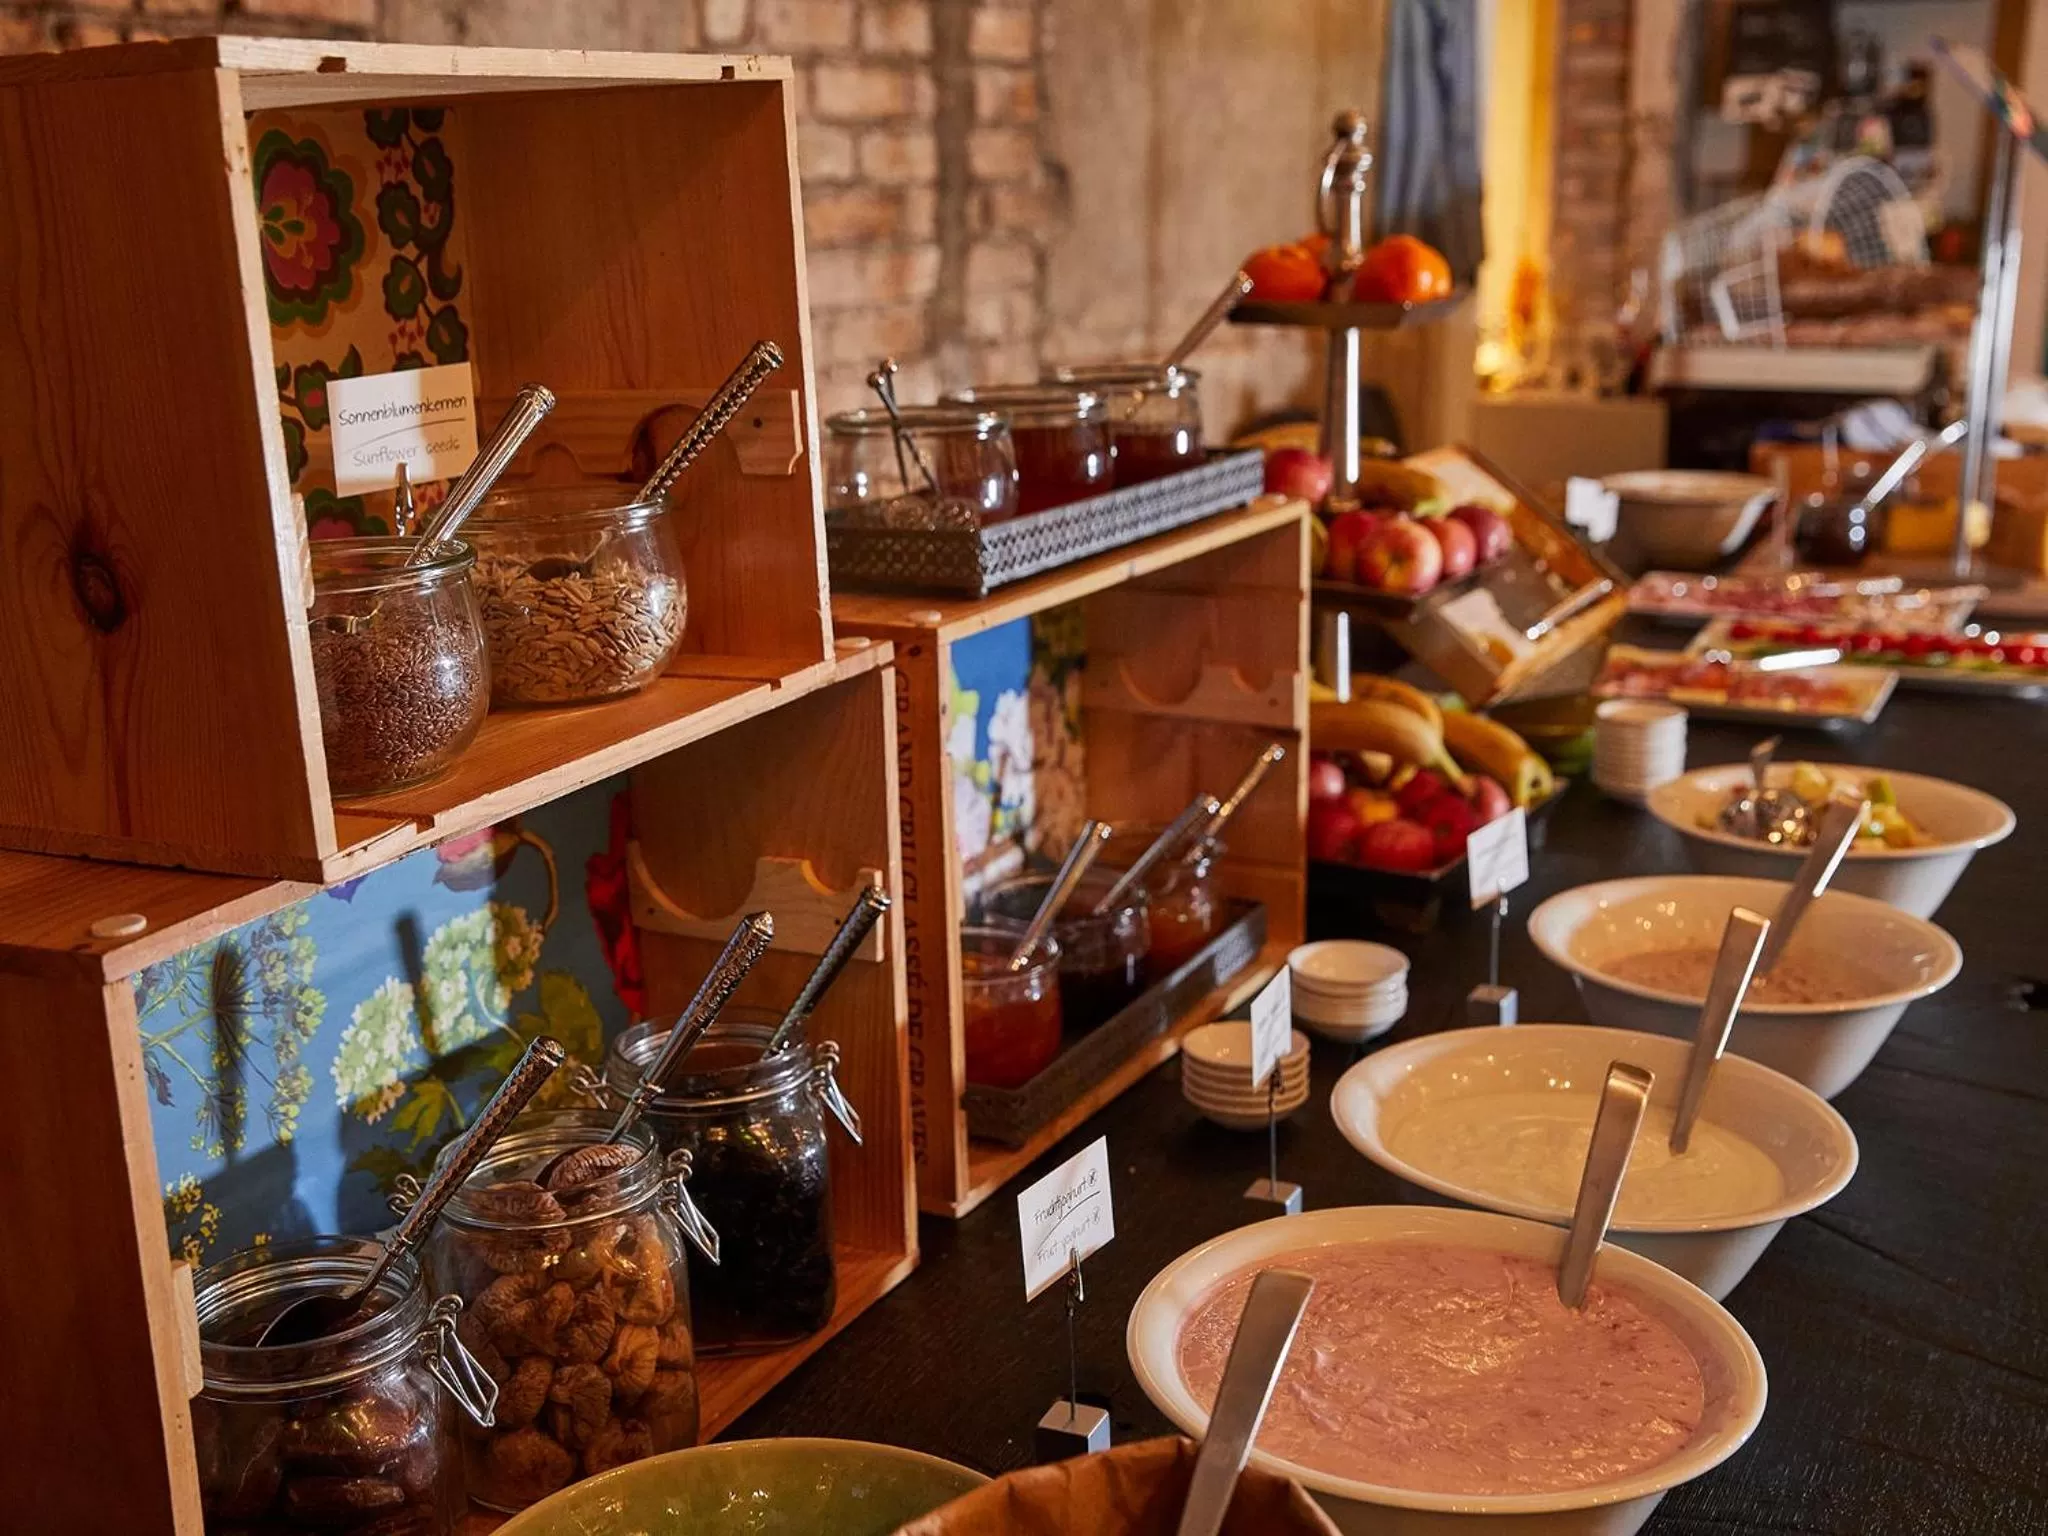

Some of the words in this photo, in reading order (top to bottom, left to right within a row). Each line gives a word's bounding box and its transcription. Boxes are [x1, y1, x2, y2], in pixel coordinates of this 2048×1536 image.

[338, 395, 468, 427] Sonnenblumenkernen
[352, 445, 417, 468] Sunflower
[426, 433, 461, 455] seeds
